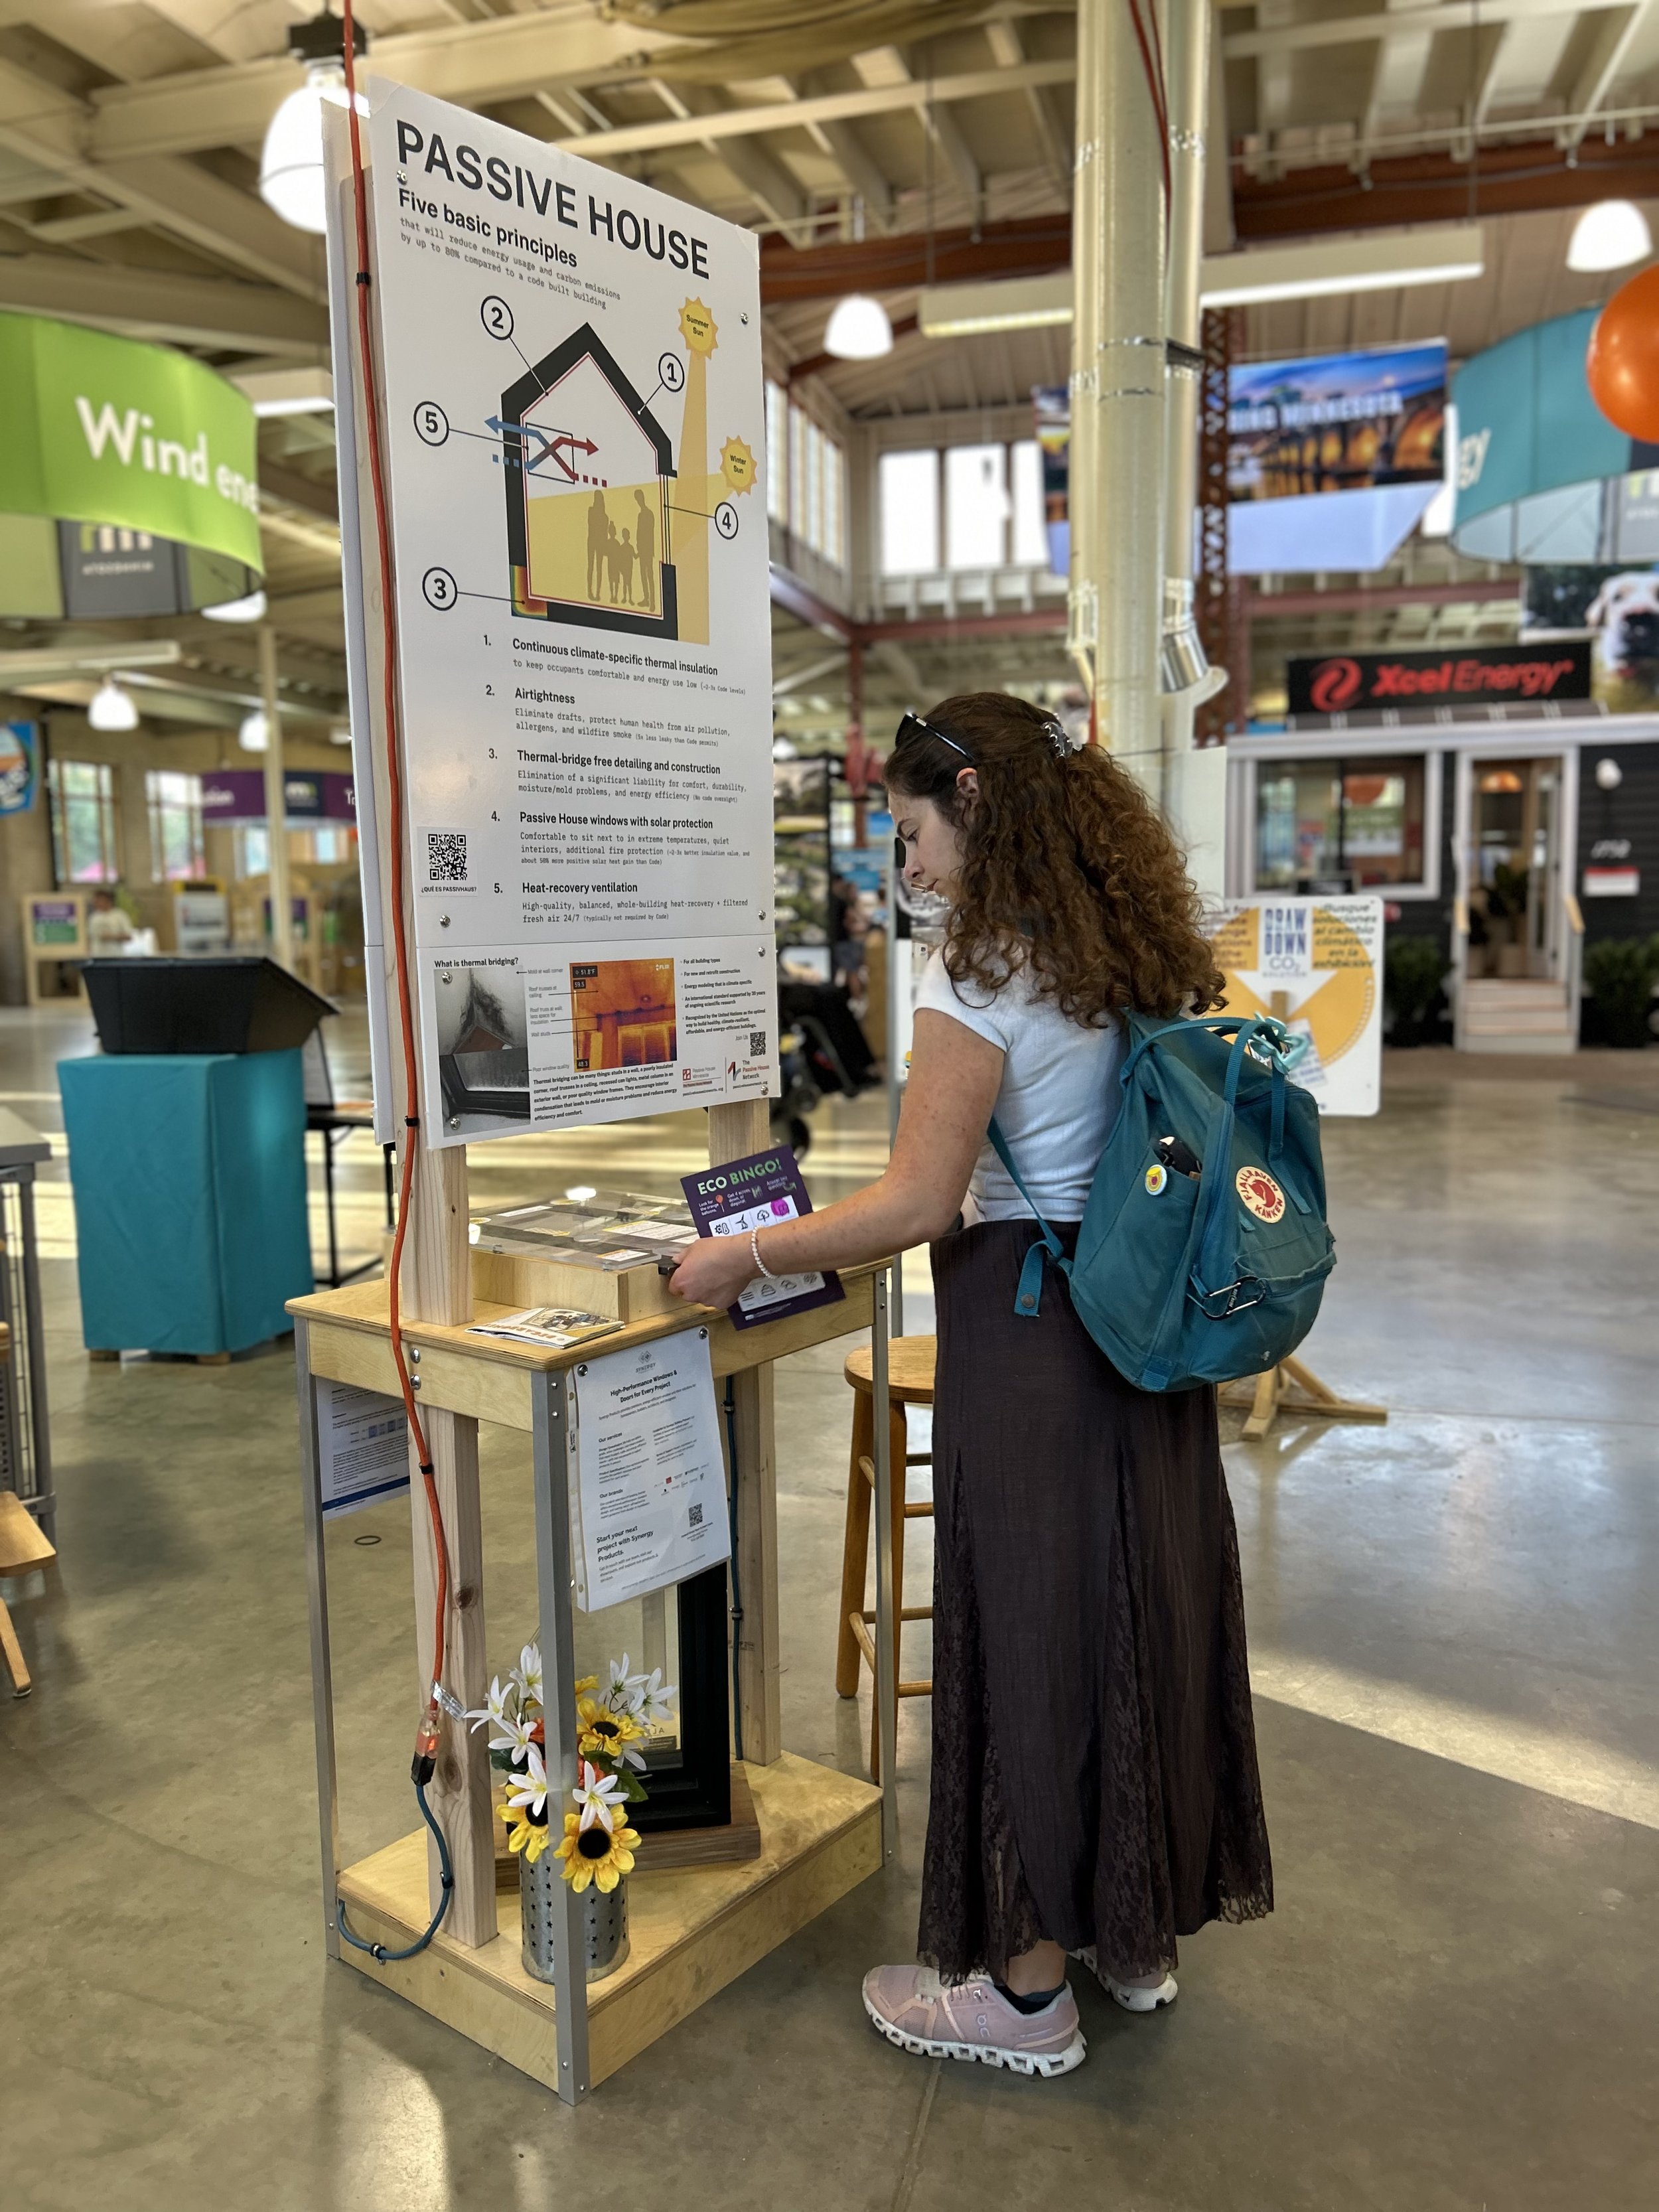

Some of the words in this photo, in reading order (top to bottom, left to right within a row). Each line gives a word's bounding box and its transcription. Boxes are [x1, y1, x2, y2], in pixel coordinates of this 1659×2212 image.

[396, 119, 578, 229] PASSIVE
[588, 194, 709, 280] HOUSE
[399, 187, 438, 218] Five
[443, 203, 491, 237] basic
[496, 226, 577, 267] principles
[399, 217, 420, 232] that
[425, 226, 444, 240] will
[449, 235, 478, 251] reduce
[482, 246, 509, 263] energy
[513, 257, 536, 271] usage
[539, 265, 552, 277] and
[556, 272, 581, 286] carbon
[585, 282, 620, 300] emissions
[401, 232, 411, 245] by
[415, 239, 426, 250] up
[430, 242, 441, 253] to
[445, 246, 460, 259] 80%
[465, 254, 501, 273] compared
[505, 267, 514, 277] to
[527, 276, 544, 287] code
[548, 281, 569, 296] built
[573, 289, 606, 310] building
[491, 306, 504, 329] 2
[685, 314, 709, 329] Summer
[693, 327, 703, 337] Sun
[666, 362, 677, 383] 1
[425, 411, 438, 433] 5
[76, 396, 209, 487] Wind
[729, 454, 747, 465] Winter
[733, 465, 744, 474] Sun
[722, 512, 731, 530] 4
[433, 577, 447, 600] 3
[512, 638, 569, 656] Continuous
[570, 646, 642, 666] climate-specific
[644, 656, 678, 670] thermal
[679, 660, 717, 676] insulation
[513, 658, 522, 667] to
[526, 660, 543, 671] keep
[547, 664, 584, 674] occupants
[587, 669, 630, 680] comfortable
[648, 676, 670, 686] energy
[686, 679, 697, 688] low
[1372, 661, 1453, 696] Xcel
[1453, 660, 1570, 696] Energy
[485, 684, 495, 696] 2.
[514, 687, 575, 704] Airtightness
[515, 707, 553, 719] Eliminate
[557, 712, 585, 723] drafts,
[589, 716, 616, 725] protect
[620, 717, 639, 727] human
[642, 720, 664, 729] health
[667, 722, 682, 731] from
[684, 724, 695, 733] air
[697, 725, 730, 737] pollution,
[516, 721, 557, 733] allergens,
[577, 727, 609, 737] wildfire
[488, 748, 498, 759] 3.
[517, 749, 592, 767] Thermal-bridge
[593, 755, 613, 767] free
[614, 757, 652, 772] detailing
[654, 760, 669, 771] and
[671, 763, 720, 774] construction
[518, 770, 564, 780] Elimination
[587, 774, 630, 784] significant
[632, 776, 665, 788] liability
[682, 780, 708, 790] comfort,
[712, 782, 747, 792] durability,
[518, 783, 573, 794] moisture/mold
[576, 786, 611, 797] problems,
[629, 790, 652, 800] energy
[655, 790, 689, 802] efficiency
[491, 810, 500, 822] 4.
[520, 811, 556, 824] Passive
[559, 812, 588, 824] House
[589, 814, 628, 826] windows
[630, 816, 648, 827] with
[650, 816, 671, 827] solar
[672, 818, 713, 830] protection
[520, 832, 566, 841] Comfortable
[581, 833, 593, 842] sit
[666, 836, 709, 845] temperatures,
[713, 837, 729, 846] quiet
[521, 844, 561, 854] interiors,
[566, 846, 605, 854] additional
[494, 883, 503, 893] 5.
[522, 882, 589, 895] Heat-recovery
[591, 881, 638, 893] ventilation
[522, 901, 575, 911] High-quality,
[579, 901, 613, 909] balanced,
[616, 900, 668, 909] whole-building
[523, 915, 543, 923] fresh
[547, 914, 559, 922] air
[563, 913, 579, 922] 24/7
[1265, 909, 1306, 930] DRAW
[1265, 933, 1305, 955] DOWN
[461, 958, 487, 967] thermal
[488, 957, 518, 966] bridging?
[697, 1176, 727, 1195] ECO
[729, 1159, 781, 1185] BINGO!
[610, 1378, 653, 1396] High-Performance
[652, 1372, 673, 1382] Windows
[620, 1394, 634, 1403] Doors
[654, 1381, 670, 1391] Project
[596, 1534, 611, 1543] Start
[611, 1530, 624, 1540] your
[597, 1541, 617, 1554] project
[618, 1537, 630, 1546] with
[631, 1530, 654, 1542] Synergy
[598, 1550, 624, 1562] Products.
